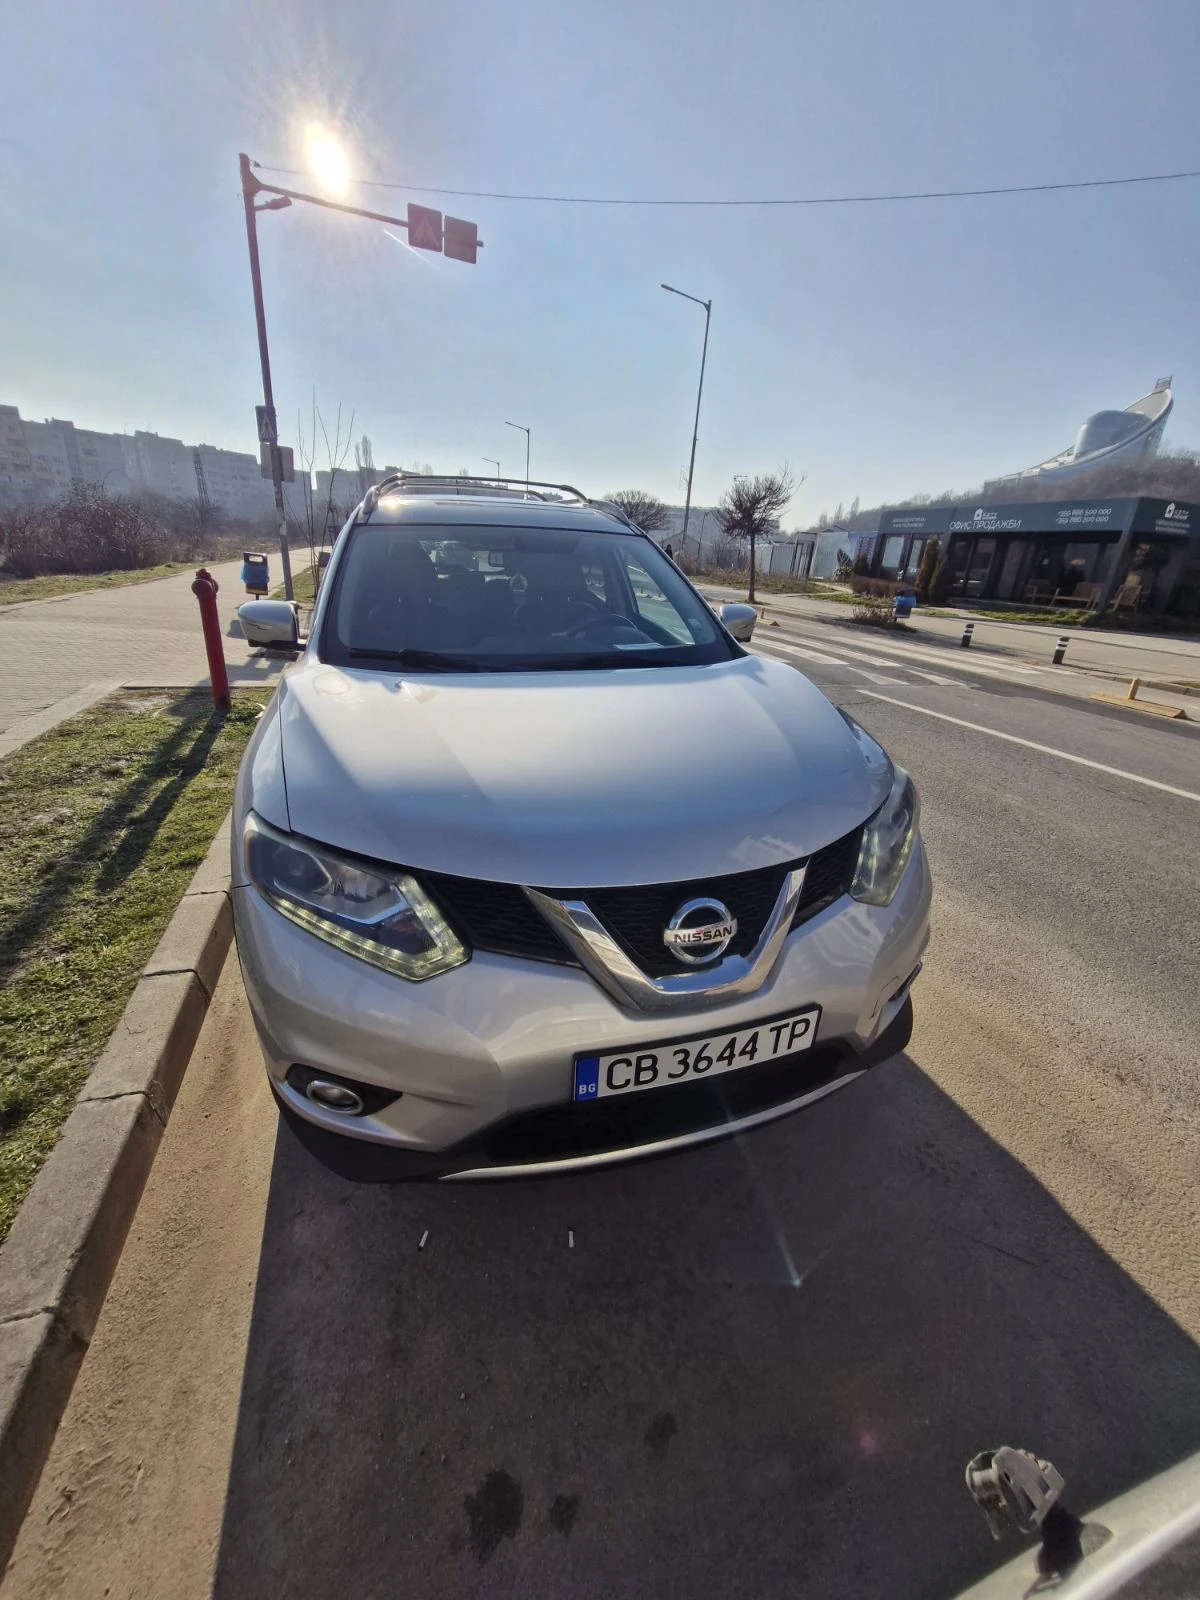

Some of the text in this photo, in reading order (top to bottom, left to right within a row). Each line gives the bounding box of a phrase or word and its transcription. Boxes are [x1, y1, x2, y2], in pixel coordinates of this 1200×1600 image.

[949, 519, 1022, 531] ОФИС ПРОДАЖБИ
[674, 926, 732, 943] NISSAN
[606, 1017, 811, 1090] CB 3644 TP
[578, 1083, 596, 1095] BG
